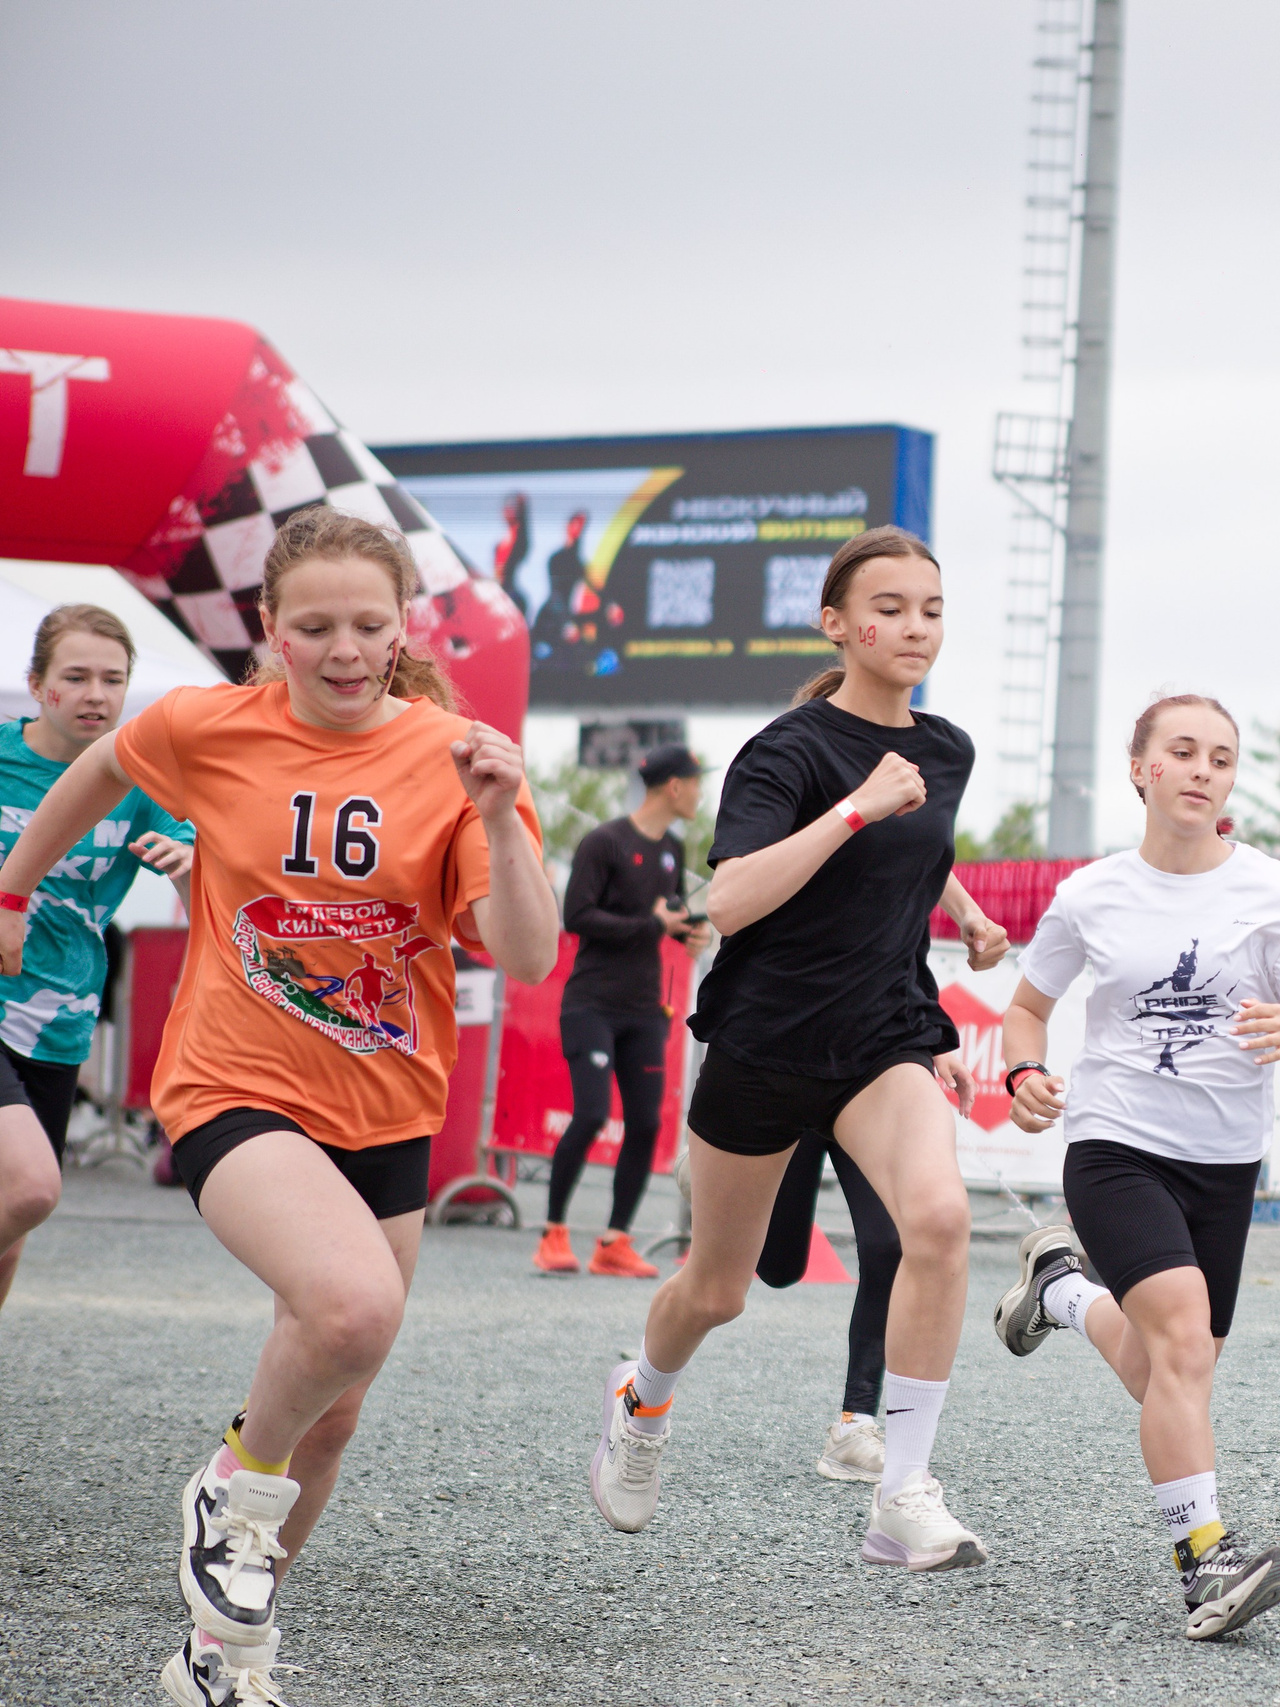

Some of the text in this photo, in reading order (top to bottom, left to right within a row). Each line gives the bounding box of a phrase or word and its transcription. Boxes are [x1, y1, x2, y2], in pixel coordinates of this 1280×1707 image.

[858, 624, 876, 647] 49
[1150, 762, 1165, 784] 54
[282, 790, 383, 881] 16
[1144, 994, 1218, 1010] PRIDE
[1153, 1024, 1217, 1040] TEAM
